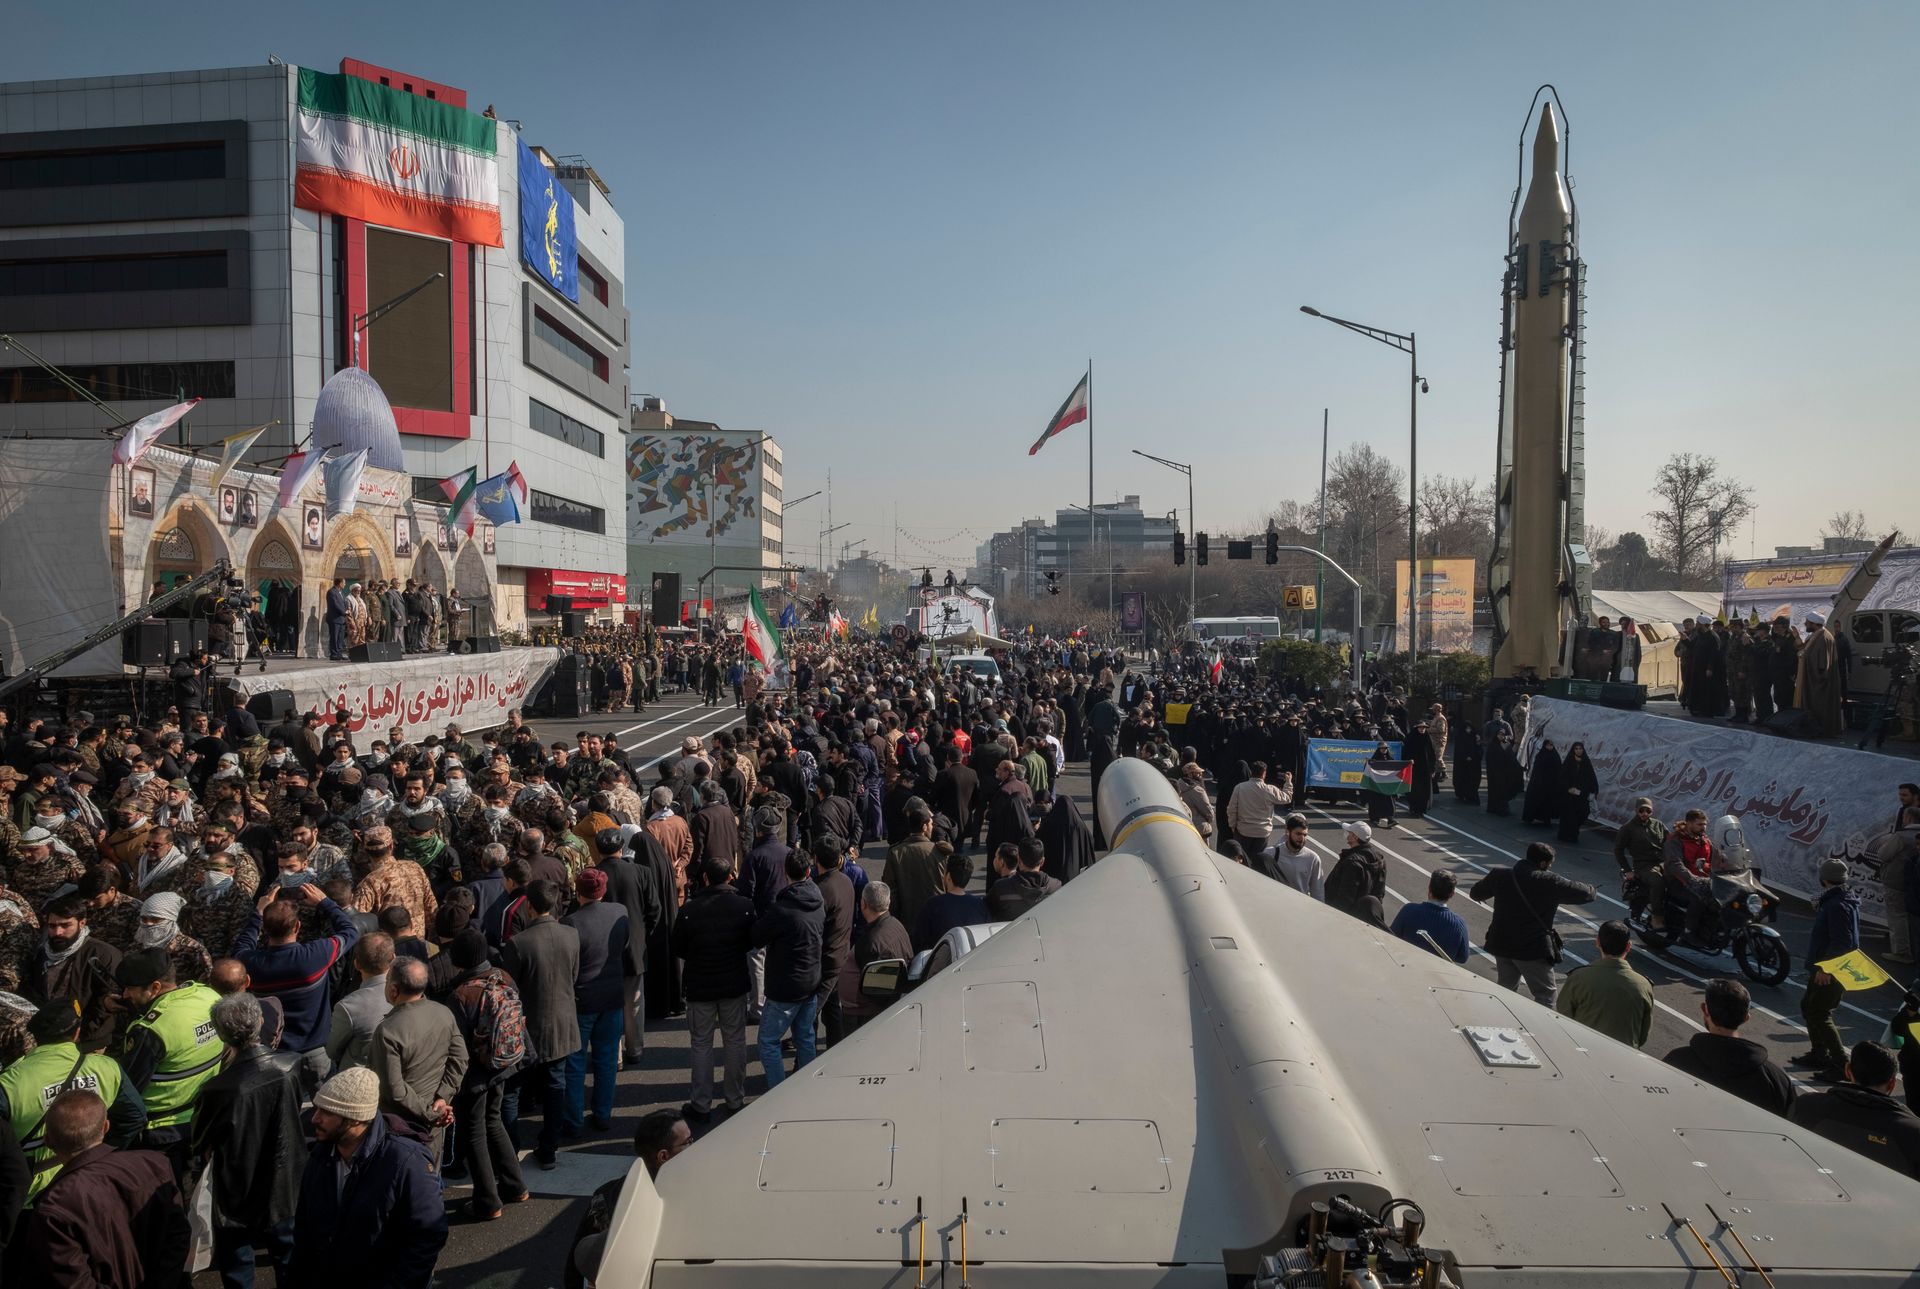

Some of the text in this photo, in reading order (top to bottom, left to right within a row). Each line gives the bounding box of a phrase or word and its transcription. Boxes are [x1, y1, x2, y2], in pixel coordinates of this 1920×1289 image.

[1788, 570, 1815, 584] راهیان
[311, 683, 348, 727] قد
[346, 681, 405, 733] راهیان
[407, 676, 450, 727] نفری
[449, 673, 476, 717] هزار
[1589, 741, 1630, 784] راهیا
[1619, 754, 1675, 792] نفری
[1655, 760, 1708, 801] هزار
[1726, 780, 1831, 845] رزمایش
[46, 1077, 97, 1098] POICE
[858, 1077, 886, 1085] 2127
[1642, 1085, 1669, 1095] 2127
[1324, 1170, 1355, 1180] 2127
